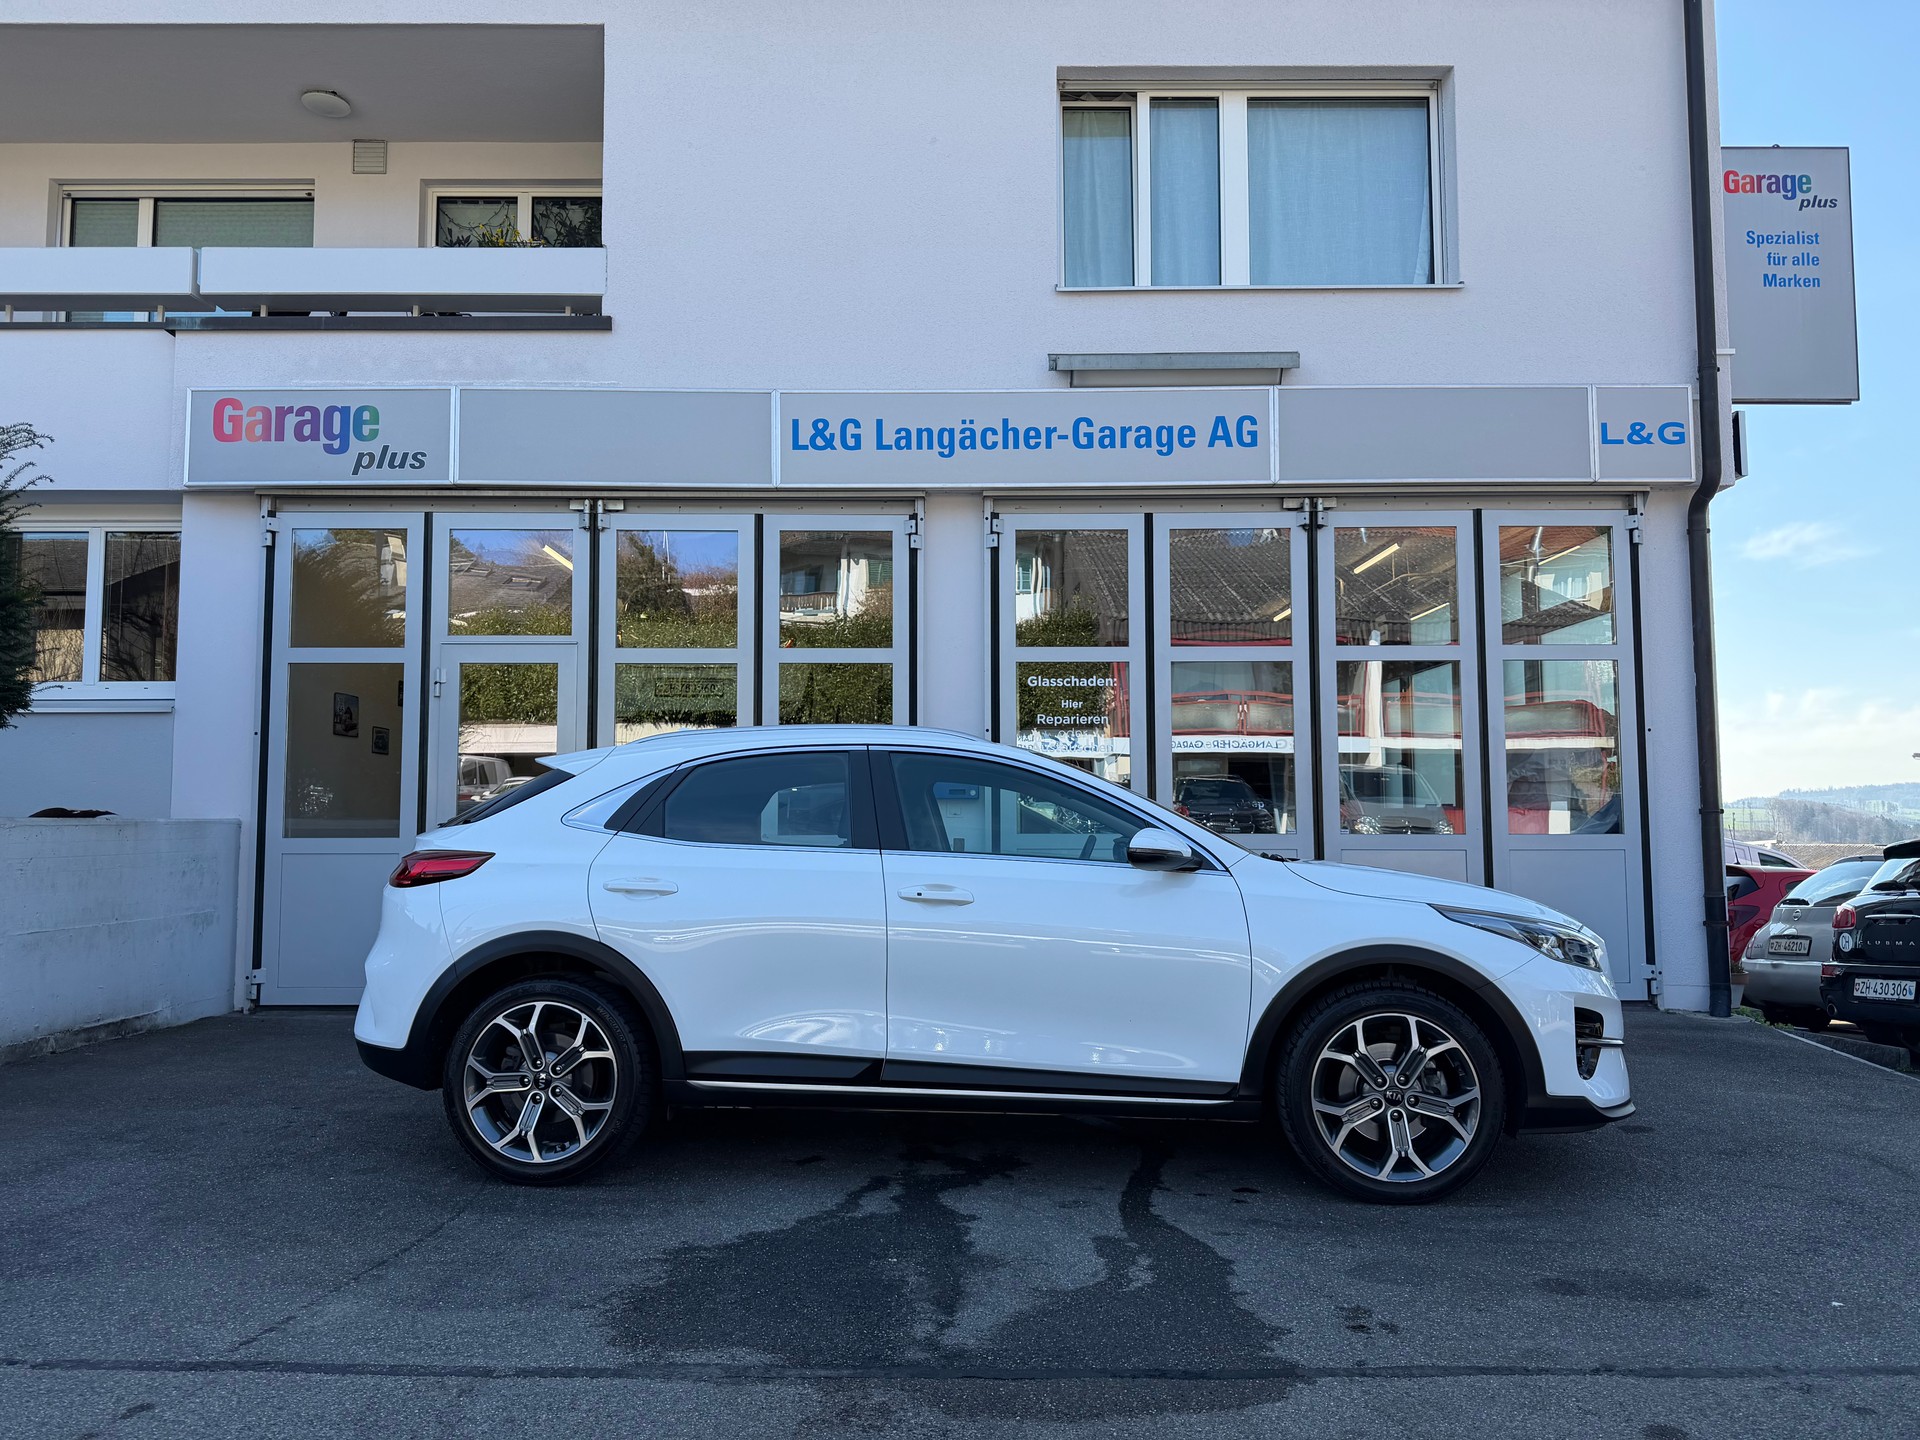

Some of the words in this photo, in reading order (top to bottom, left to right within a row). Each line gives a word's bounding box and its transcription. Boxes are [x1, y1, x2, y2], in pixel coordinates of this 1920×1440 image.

[1723, 170, 1812, 200] Garage
[1798, 195, 1838, 211] plus
[1746, 231, 1820, 248] Spezialist
[1767, 252, 1788, 266] für
[1792, 252, 1820, 266] alle
[1763, 274, 1821, 289] Marken
[212, 397, 380, 455] Garage
[1601, 422, 1686, 446] L&G
[792, 417, 862, 452] L&G
[875, 416, 1197, 459] Langächer-Garage
[1207, 414, 1259, 449] AG
[351, 444, 427, 476] plus
[1061, 699, 1084, 709] Hier
[1037, 713, 1109, 726] Reparieren
[1385, 1091, 1404, 1102] KIA
